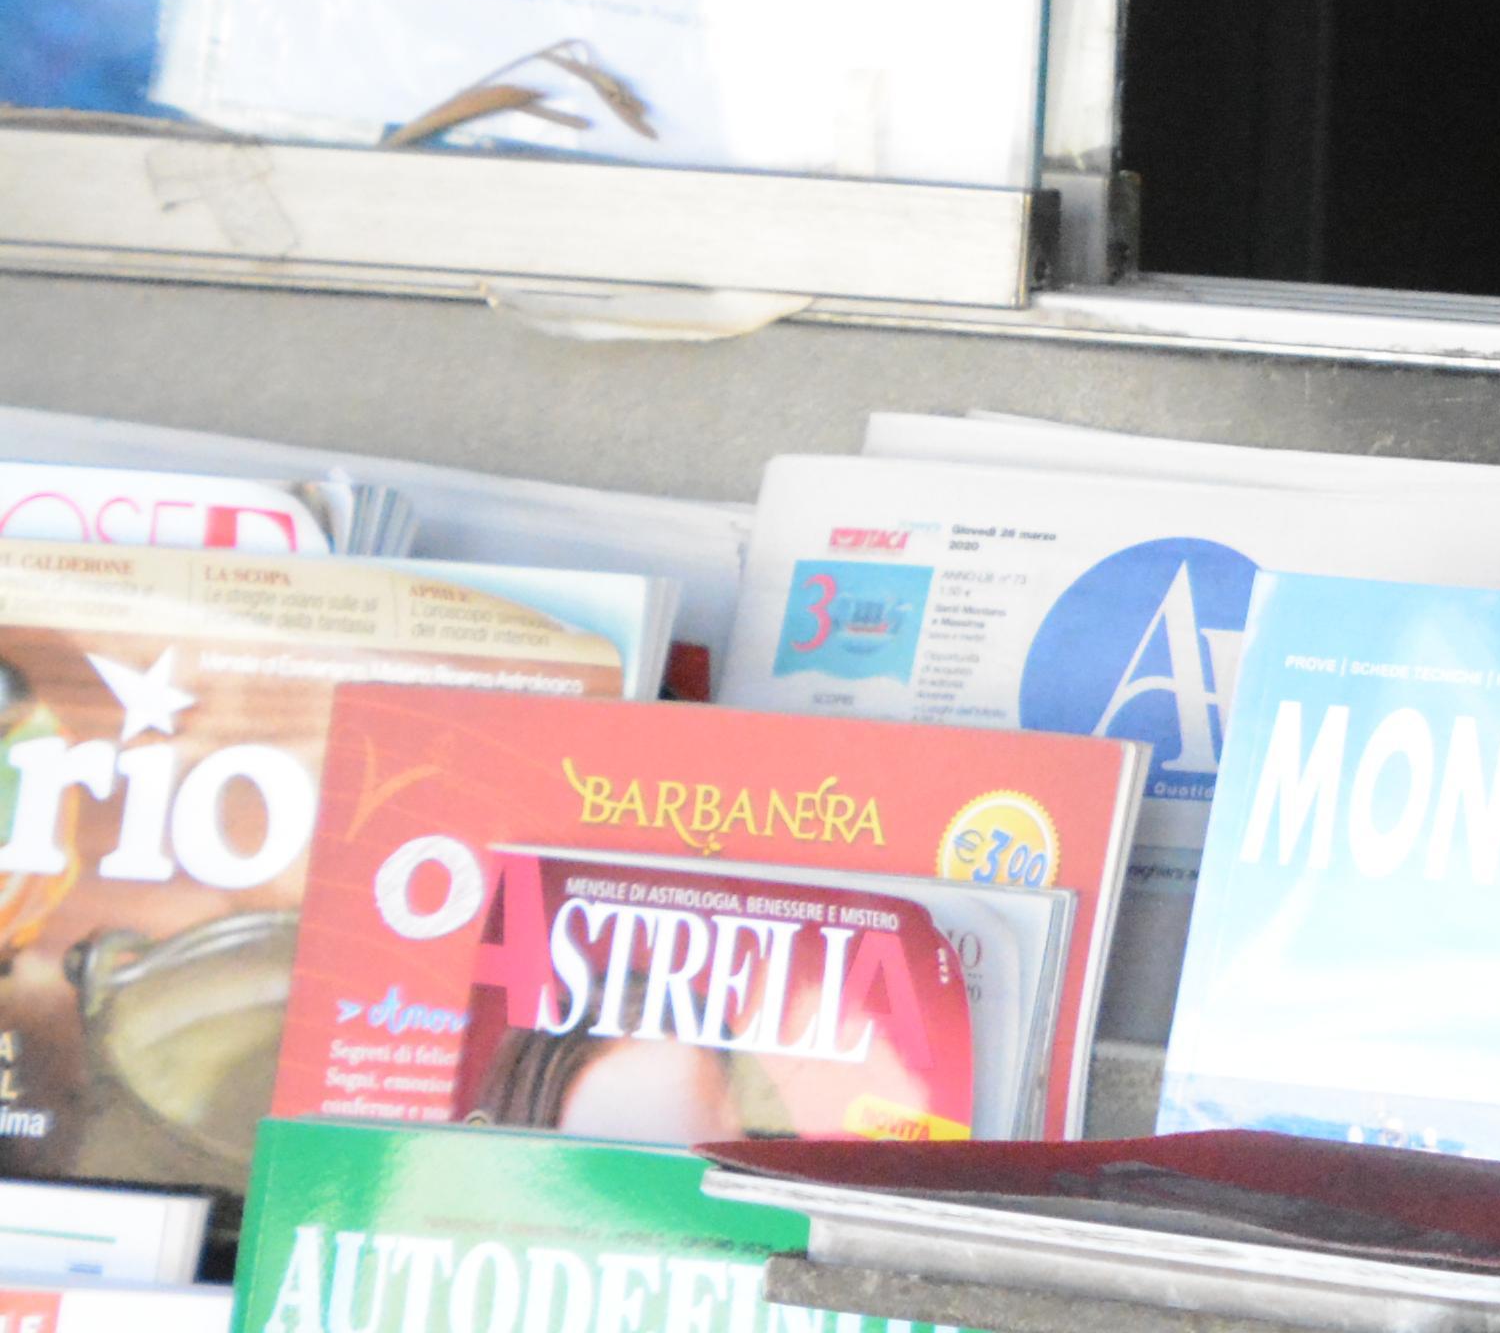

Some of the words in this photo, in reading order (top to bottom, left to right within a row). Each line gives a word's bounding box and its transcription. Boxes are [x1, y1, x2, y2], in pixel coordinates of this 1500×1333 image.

[1019, 528, 1058, 543] marzo
[1284, 653, 1337, 673] PROVE
[1350, 659, 1409, 680] SCHEDE
[562, 757, 887, 855] BARBANERA
[565, 875, 627, 900] MENSILE
[629, 882, 645, 902] DI
[646, 884, 743, 914] ASTROLOGIA,
[746, 895, 825, 921] BENESSERE
[840, 904, 899, 931] MISTERO
